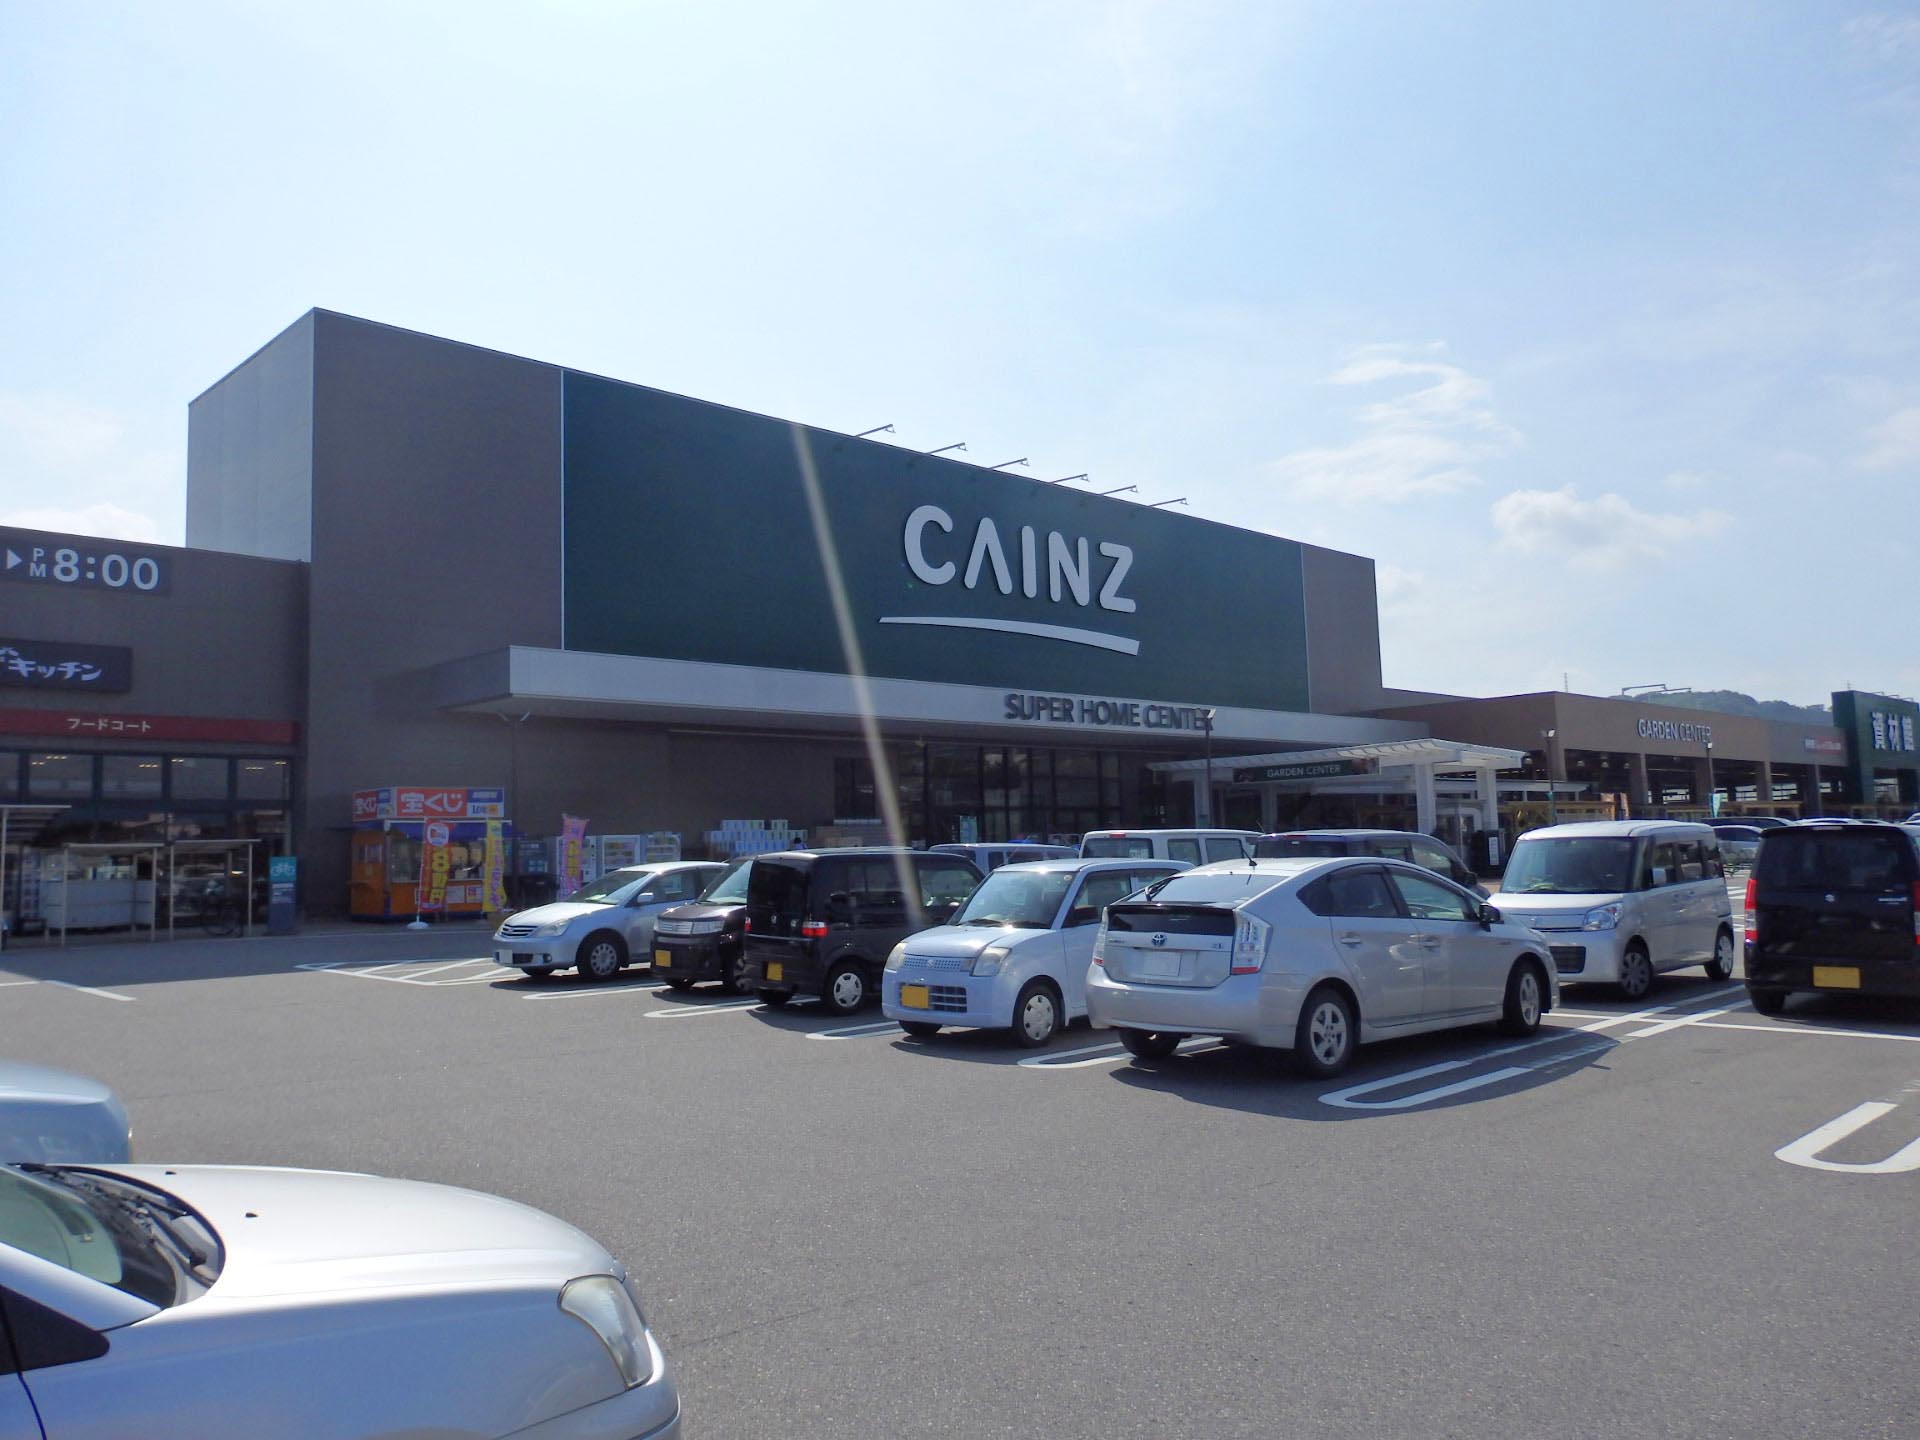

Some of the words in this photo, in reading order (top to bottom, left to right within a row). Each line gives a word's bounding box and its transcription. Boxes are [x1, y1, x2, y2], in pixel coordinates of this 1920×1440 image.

[53, 549, 159, 590] 8:00
[905, 505, 1137, 613] CAINZ
[1004, 693, 1075, 722] SUPER
[1080, 699, 1141, 727] HOME
[67, 718, 151, 733] フードコート
[1637, 719, 1678, 740] GARDEN
[1679, 723, 1712, 743] CENTER
[1267, 767, 1304, 778] GARDEN
[1306, 764, 1341, 775] CENTER
[401, 791, 463, 813] 宝くじ
